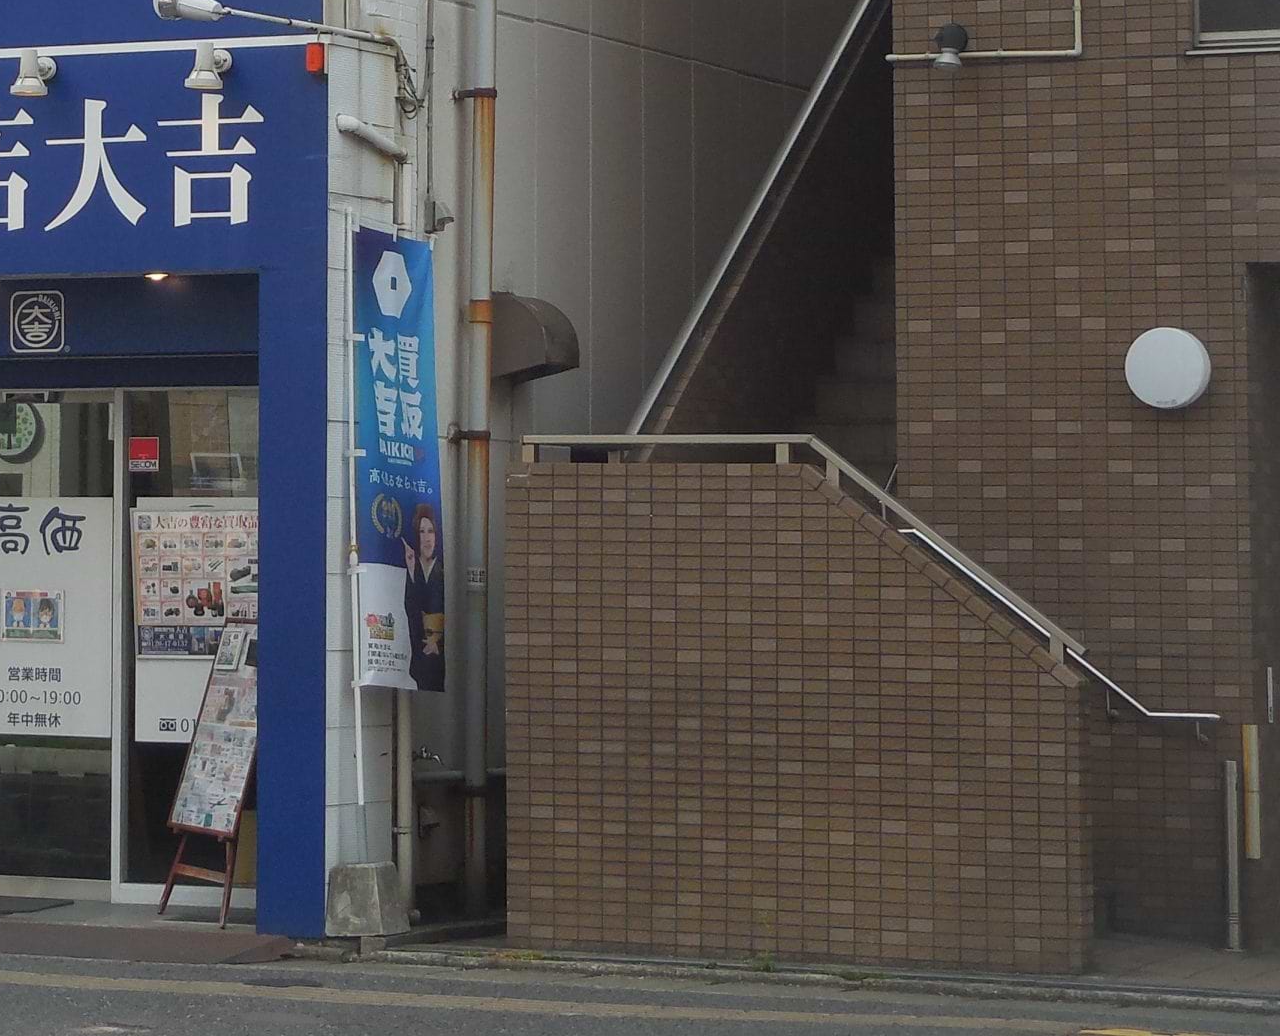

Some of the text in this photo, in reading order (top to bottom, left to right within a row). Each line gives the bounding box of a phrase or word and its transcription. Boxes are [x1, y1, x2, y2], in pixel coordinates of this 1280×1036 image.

[130, 460, 157, 469] SECOM
[7, 667, 61, 682] 営業時間
[7, 711, 61, 728] 年中無休
